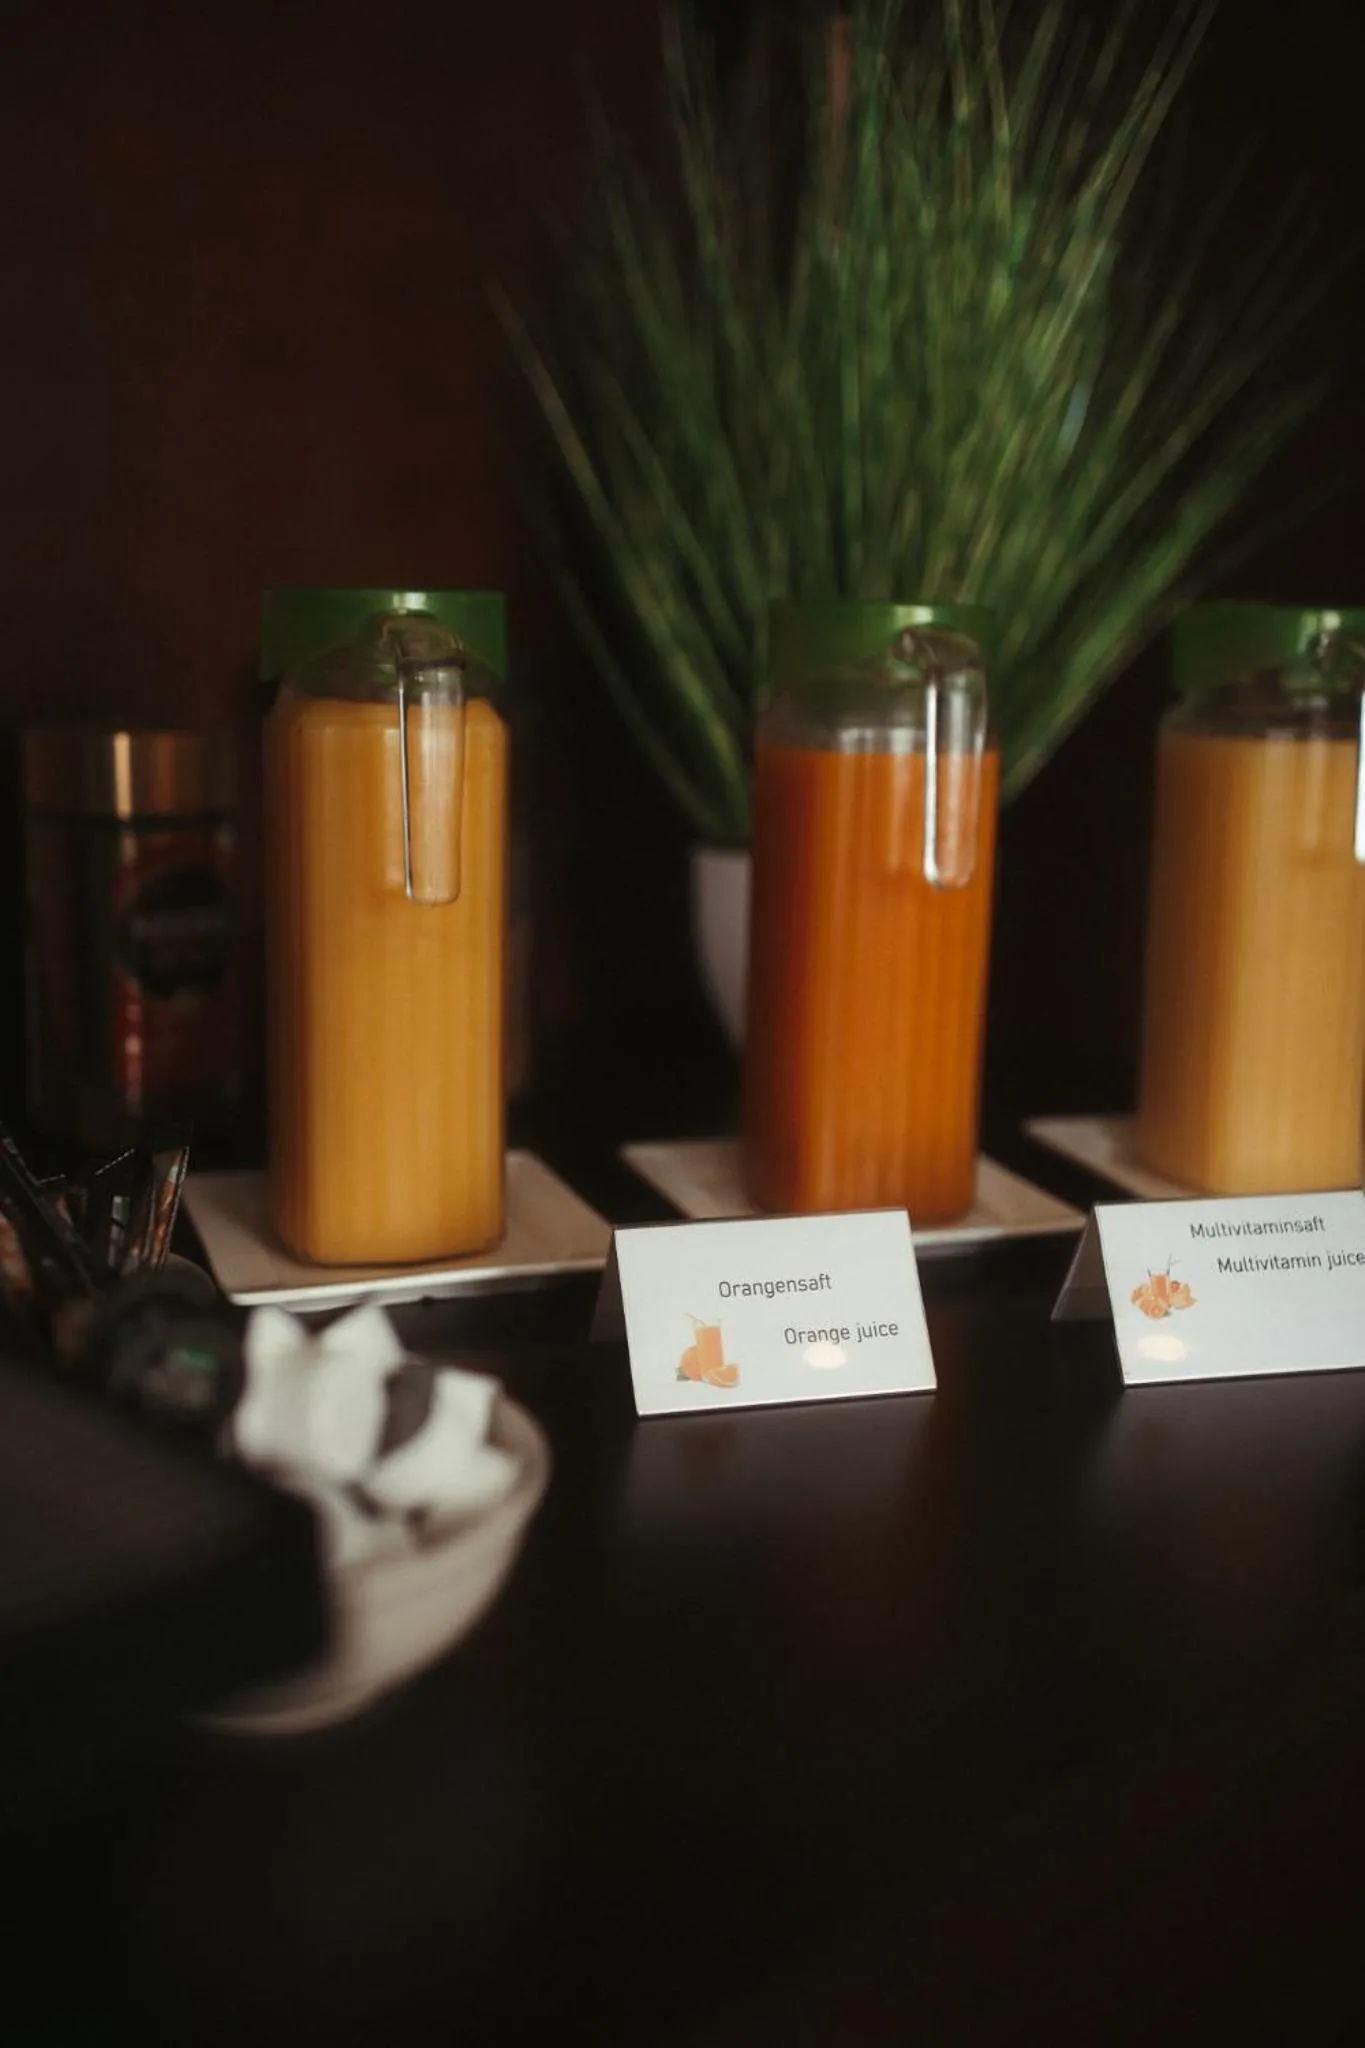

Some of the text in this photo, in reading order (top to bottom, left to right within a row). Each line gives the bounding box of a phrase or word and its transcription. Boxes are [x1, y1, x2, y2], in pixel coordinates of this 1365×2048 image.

[1190, 1216, 1326, 1238] Multivitaminsaft
[1217, 1250, 1365, 1273] Multivitamin juice
[718, 1273, 832, 1298] Orangensaft
[784, 1321, 899, 1345] Orange juice
